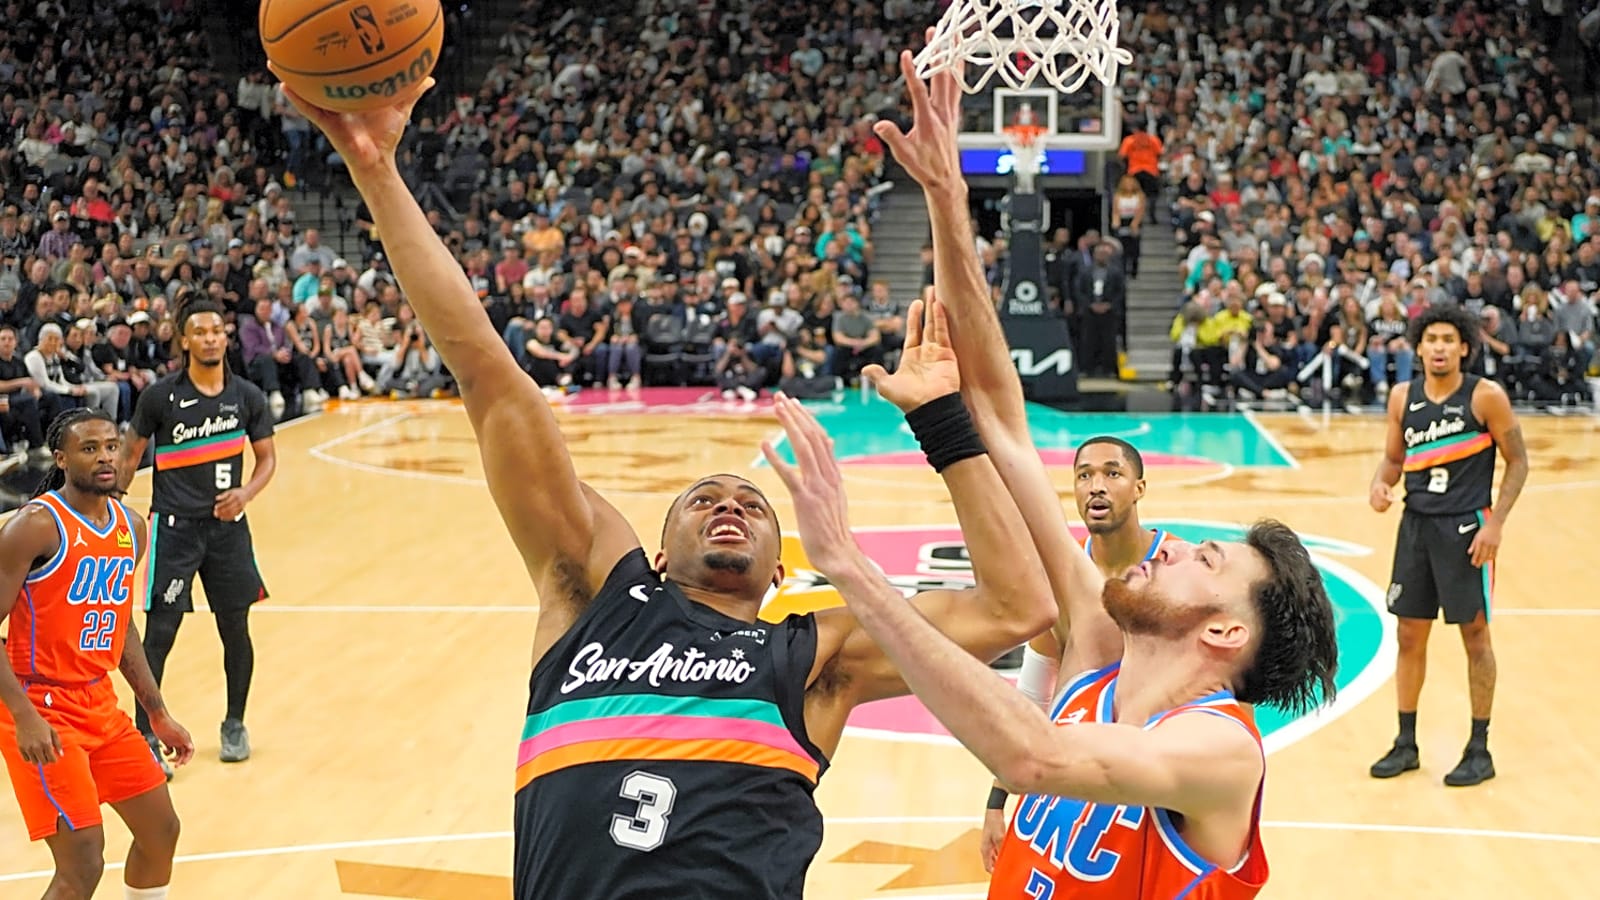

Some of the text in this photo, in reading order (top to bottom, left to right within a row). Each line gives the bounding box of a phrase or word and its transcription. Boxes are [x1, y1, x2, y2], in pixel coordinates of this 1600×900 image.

[323, 48, 433, 99] Wilson
[172, 415, 239, 445] San Antonio
[1404, 426, 1425, 448] San
[215, 463, 232, 489] 5
[1427, 467, 1449, 493] 2
[67, 555, 135, 605] OKC
[80, 609, 117, 651] 22
[560, 642, 756, 694] San Antonio
[609, 770, 678, 852] 3
[1014, 793, 1146, 882] OKC
